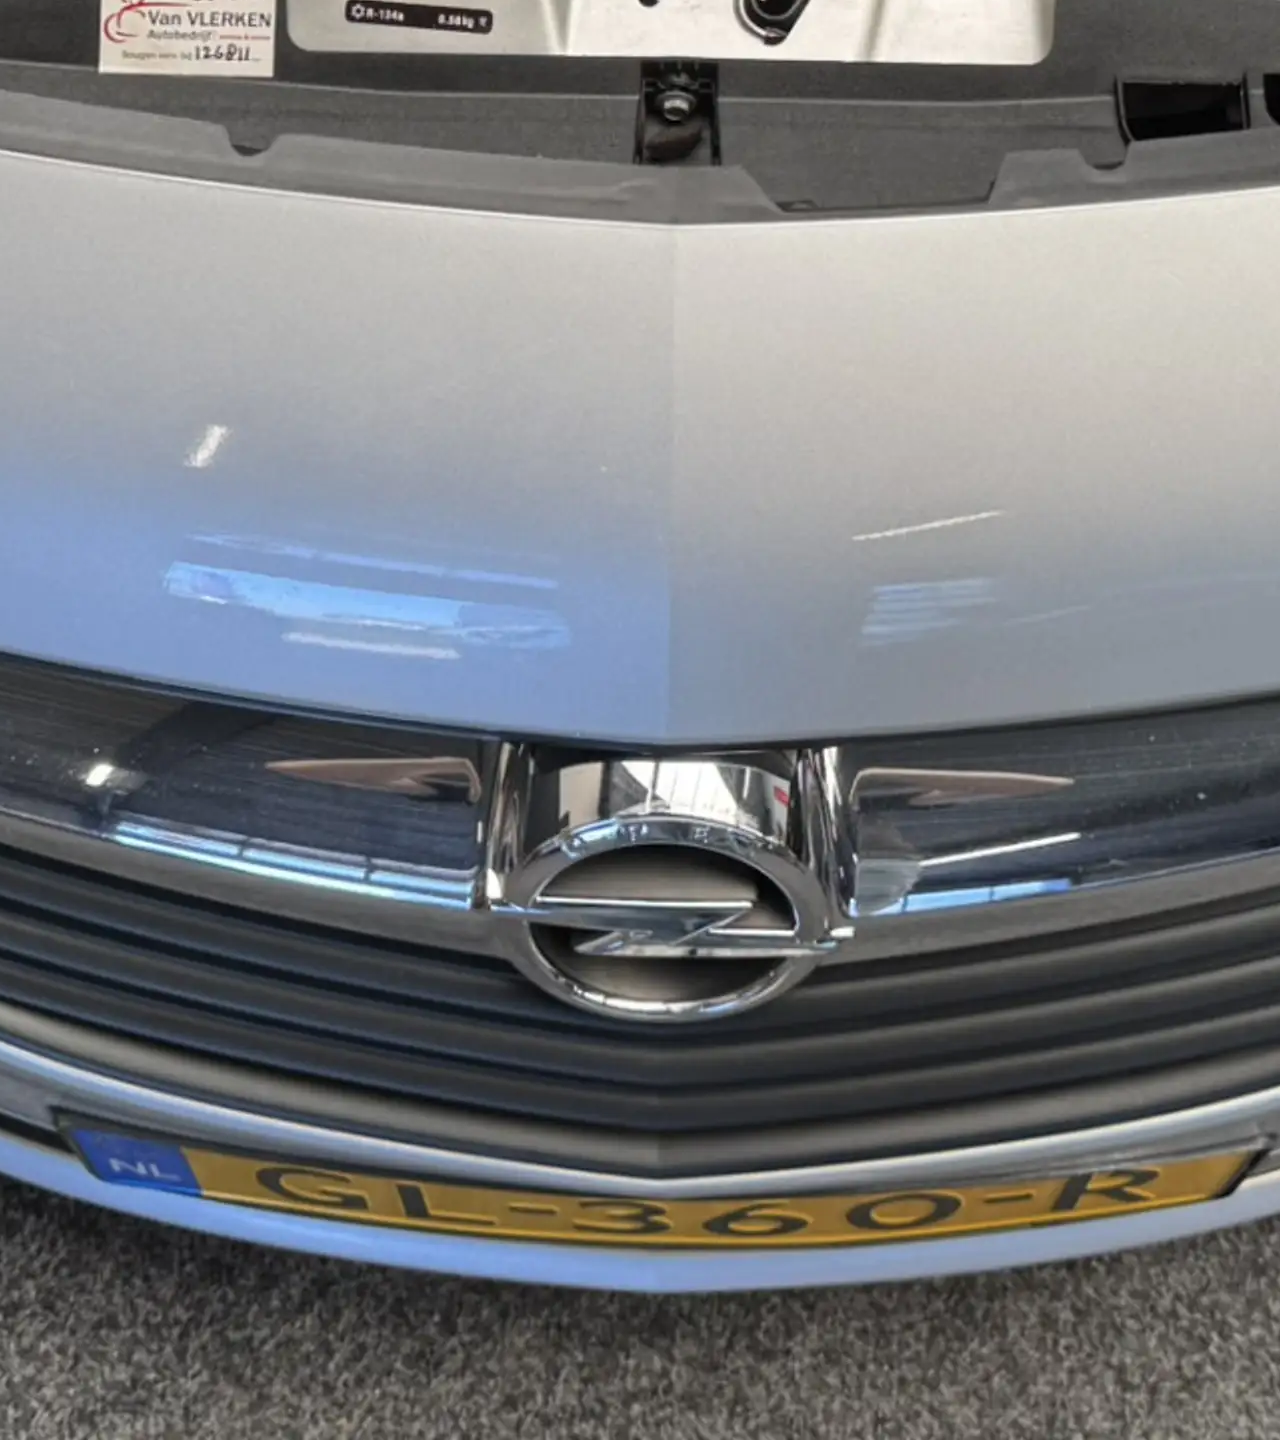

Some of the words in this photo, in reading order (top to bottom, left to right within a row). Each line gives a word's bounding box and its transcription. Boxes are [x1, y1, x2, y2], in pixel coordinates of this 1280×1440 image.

[147, 10, 182, 26] Van
[187, 10, 273, 28] VLERKEN
[107, 1157, 182, 1182] NL
[254, 1165, 1167, 1238] GL-360-R
